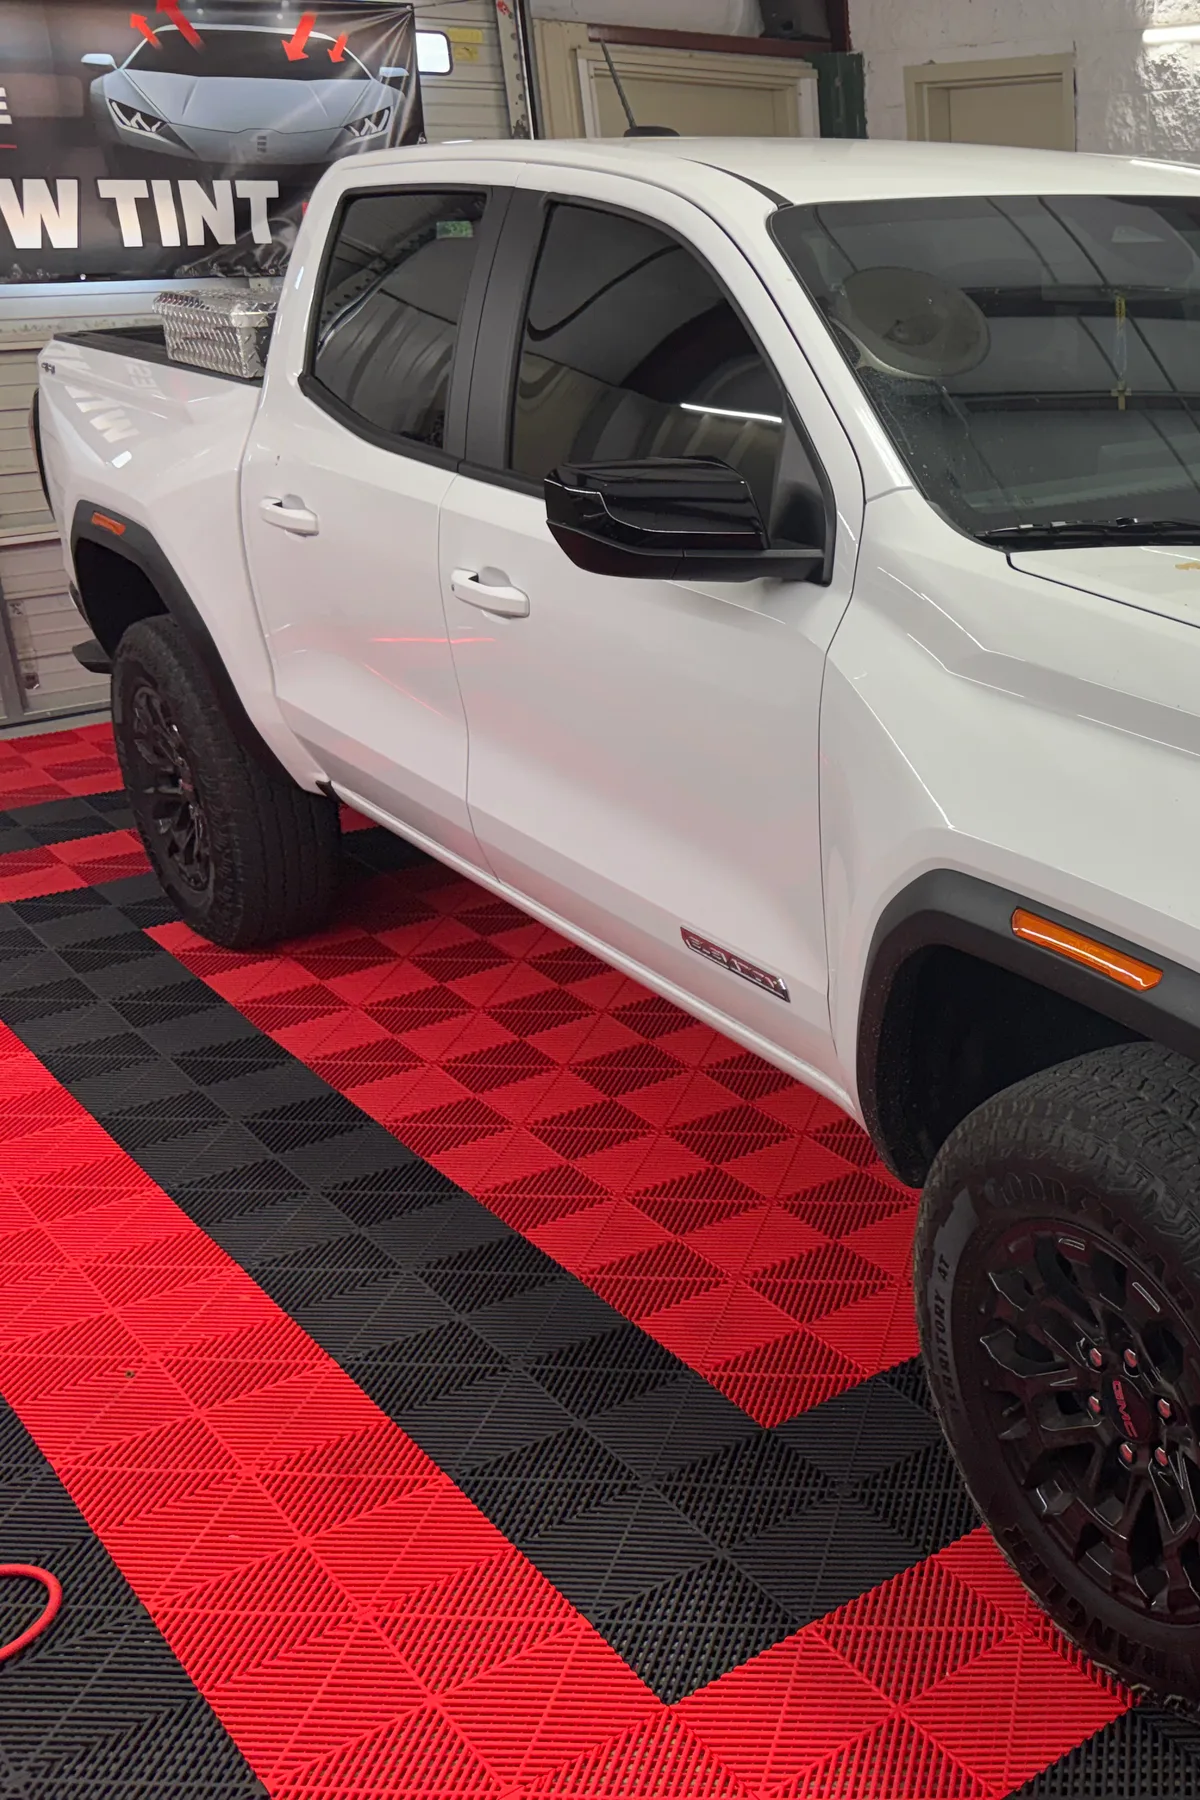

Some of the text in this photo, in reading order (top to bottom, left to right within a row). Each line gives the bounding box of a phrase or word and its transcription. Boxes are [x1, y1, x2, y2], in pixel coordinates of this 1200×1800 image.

[97, 180, 279, 247] TINT
[937, 1253, 951, 1282] AT
[1111, 1379, 1139, 1439] GMC
